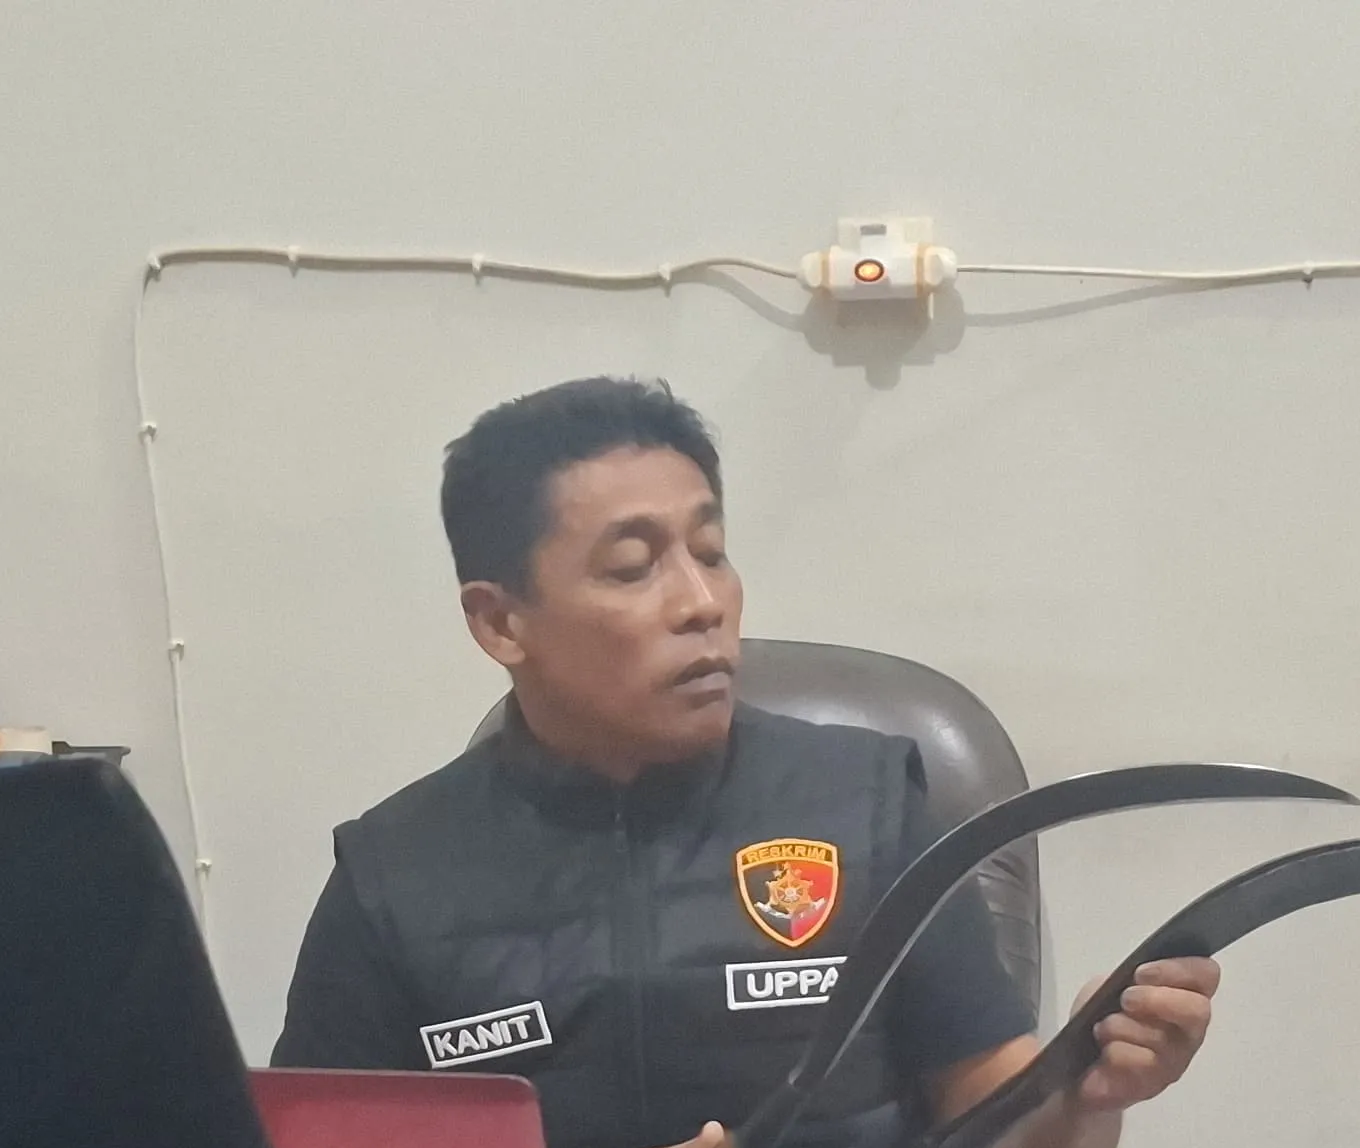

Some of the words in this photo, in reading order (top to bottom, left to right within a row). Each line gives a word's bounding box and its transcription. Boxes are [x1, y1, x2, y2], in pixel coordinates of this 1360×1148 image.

[746, 844, 827, 863] RESKRIM
[746, 966, 839, 999] UPPA
[433, 1014, 531, 1058] KANIT
